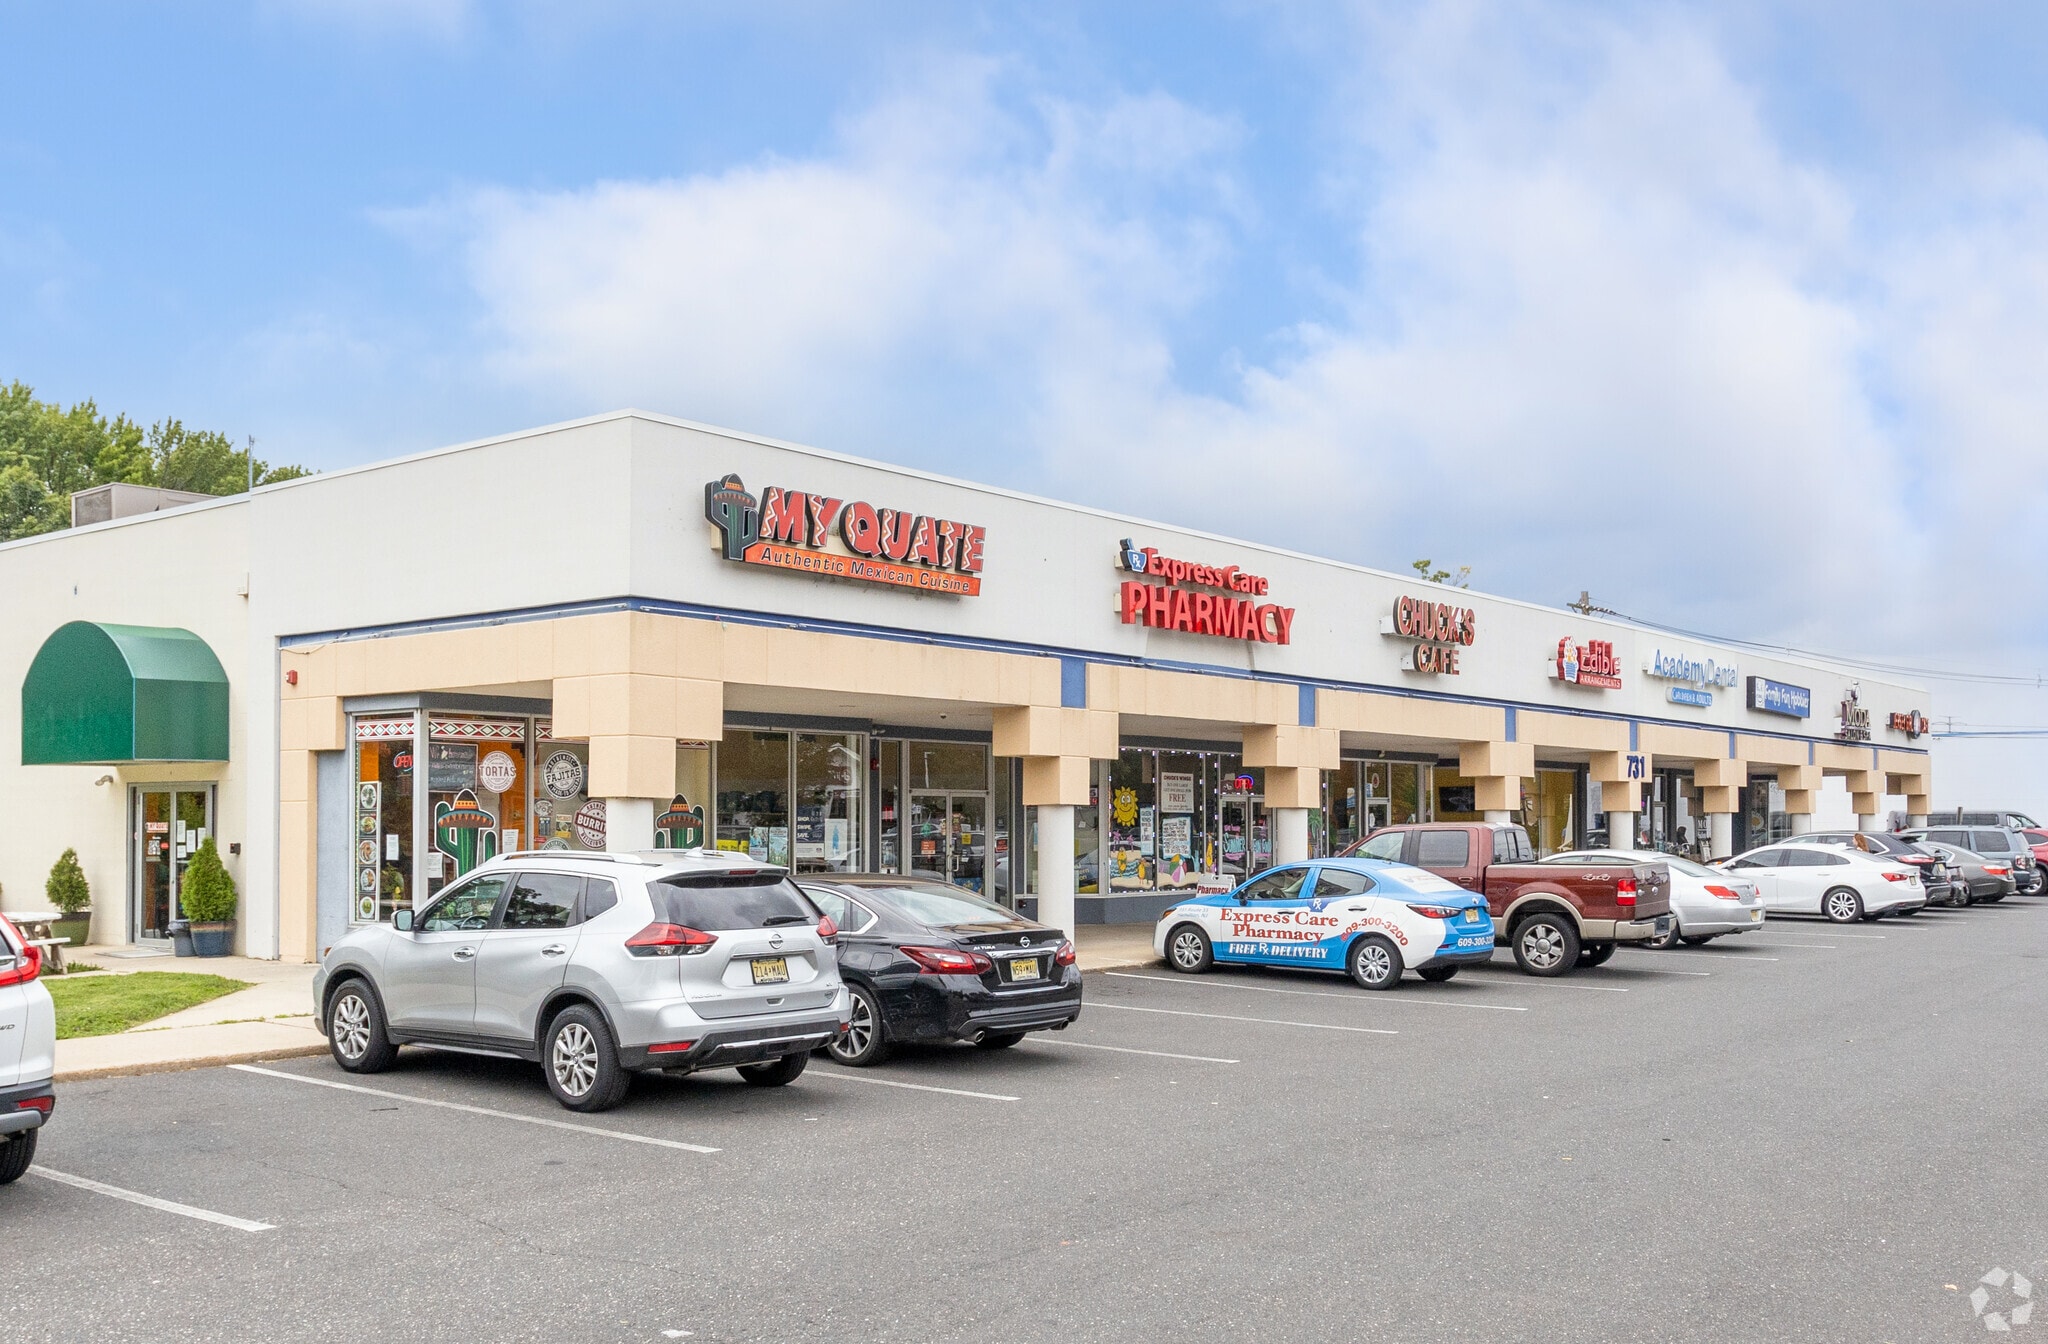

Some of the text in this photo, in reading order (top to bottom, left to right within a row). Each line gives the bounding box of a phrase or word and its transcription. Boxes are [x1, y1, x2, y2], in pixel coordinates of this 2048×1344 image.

[759, 486, 986, 573] MY QUATE
[760, 547, 970, 592] Authentic Mexican Cuisine
[1141, 547, 1269, 595] Express Care
[1121, 581, 1296, 645] PHARMACY
[1394, 595, 1475, 646] CHUCK'S
[1414, 643, 1460, 675] CAFE
[1577, 640, 1621, 676] Edible
[1653, 649, 1738, 689] Academy Dental
[1580, 675, 1620, 688] ARRANGEMENTS
[1843, 701, 1871, 729] MODA
[480, 766, 516, 777] TORTAS
[546, 767, 581, 784] FAJITAS
[1626, 754, 1645, 779] 731
[1234, 778, 1253, 789] OPEN
[1169, 793, 1187, 803] FREE
[577, 813, 606, 833] BURRI
[1197, 886, 1229, 895] Pharmacy
[1220, 908, 1339, 927] Express Care
[1232, 923, 1324, 947] Pharmacy
[1341, 917, 1409, 947] 609-300-3200
[1228, 943, 1257, 954] FREE
[1271, 945, 1329, 959] DELIVERY
